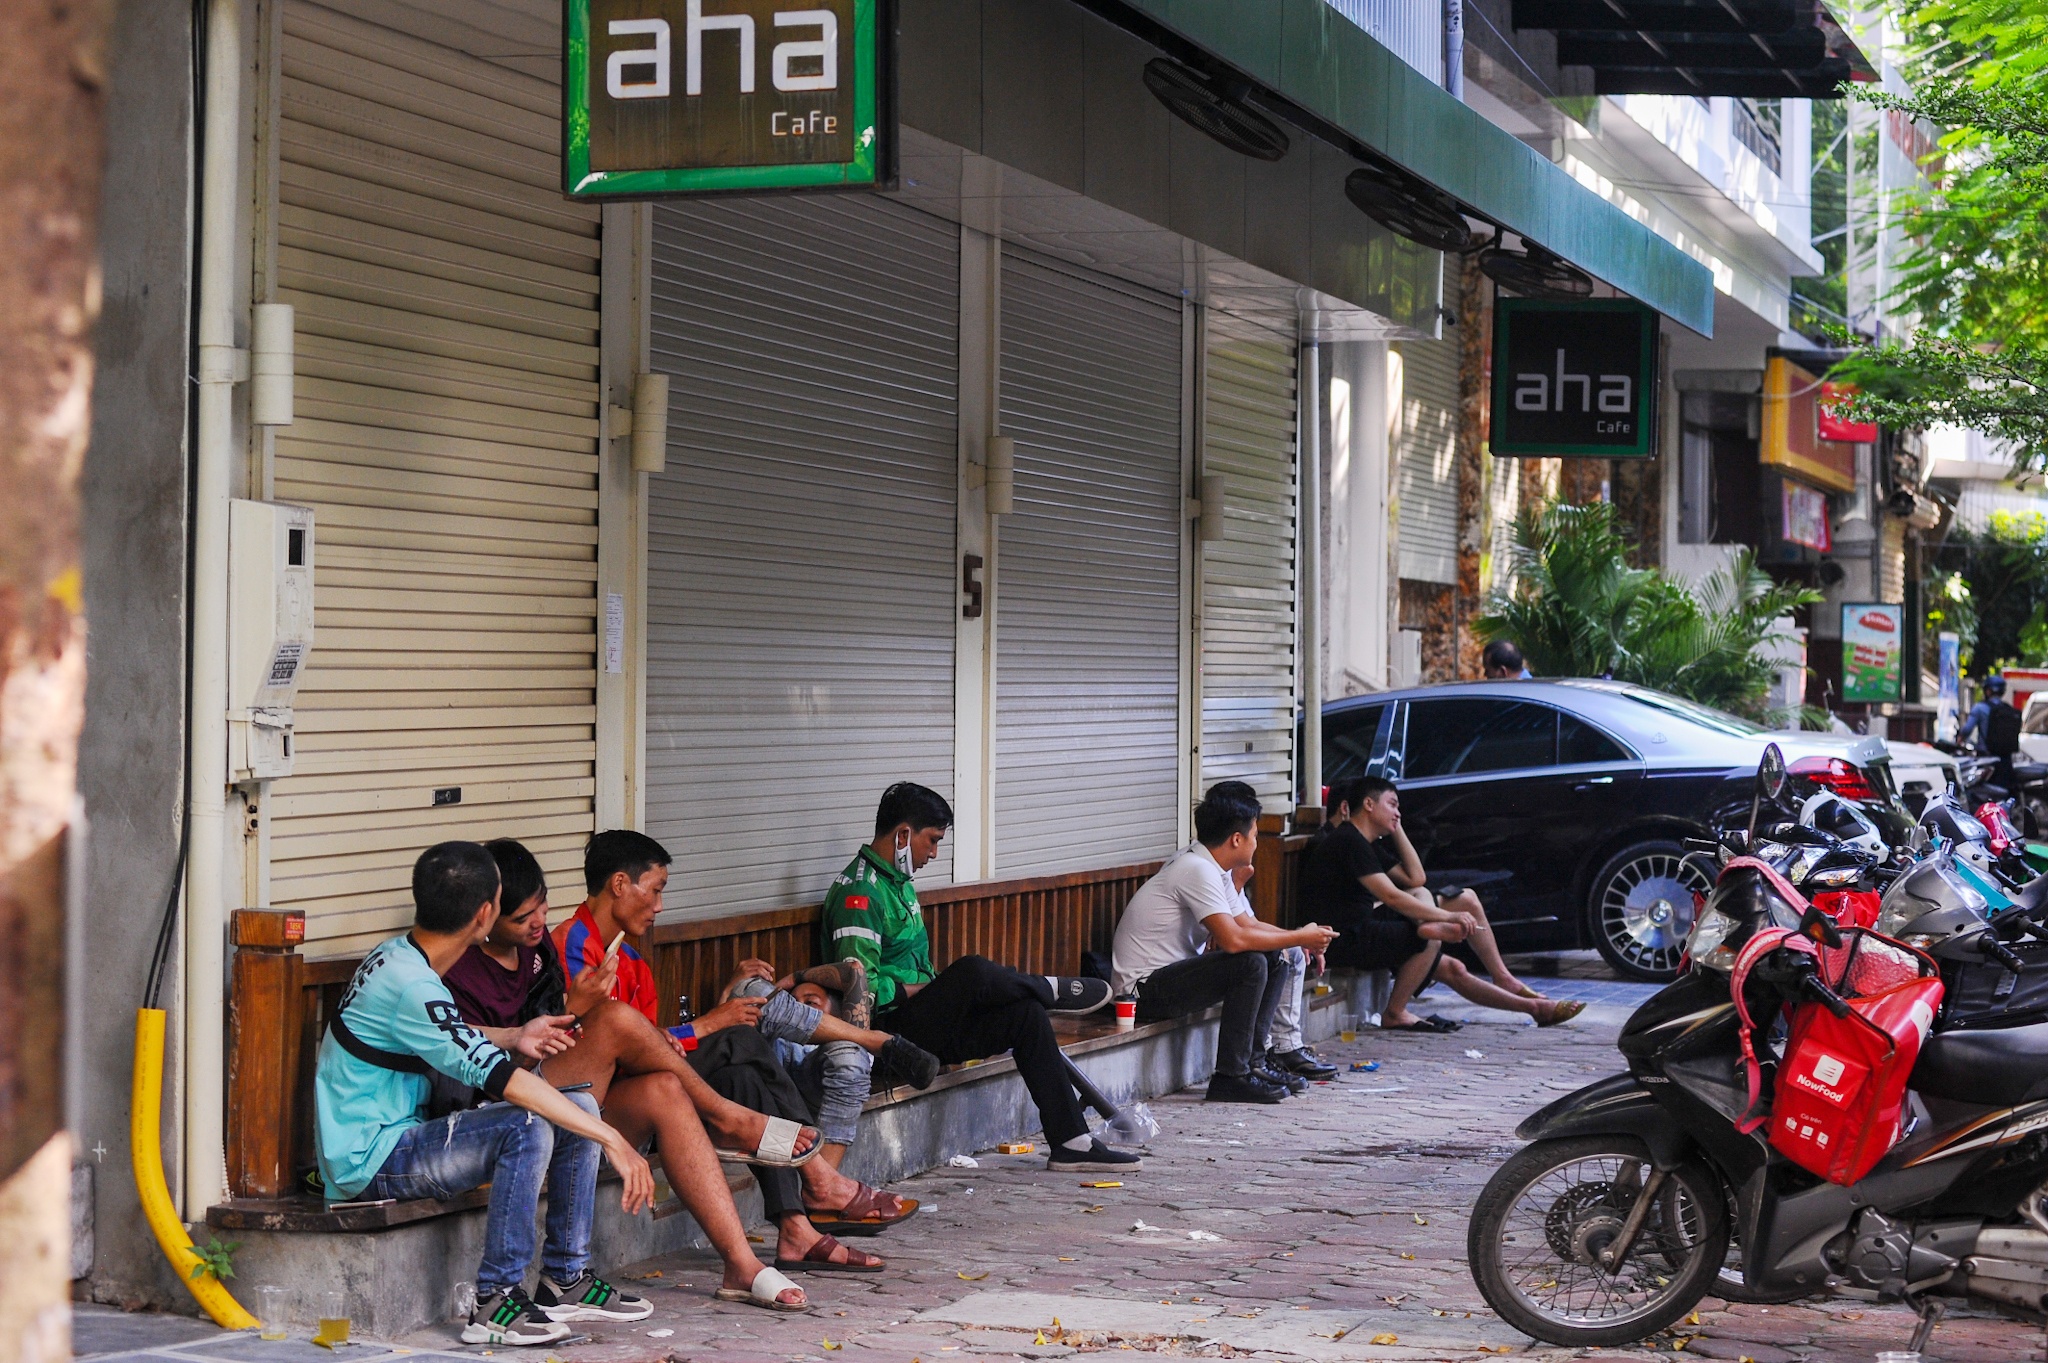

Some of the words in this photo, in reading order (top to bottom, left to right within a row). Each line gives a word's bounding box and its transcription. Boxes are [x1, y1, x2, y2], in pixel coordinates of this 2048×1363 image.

[606, 0, 838, 99] aha
[771, 110, 838, 136] Cafe
[1515, 348, 1632, 413] aha
[1596, 420, 1631, 434] Cafe
[963, 554, 983, 618] 5
[1639, 1076, 1670, 1084] HONDA
[1796, 1074, 1844, 1102] NowFood
